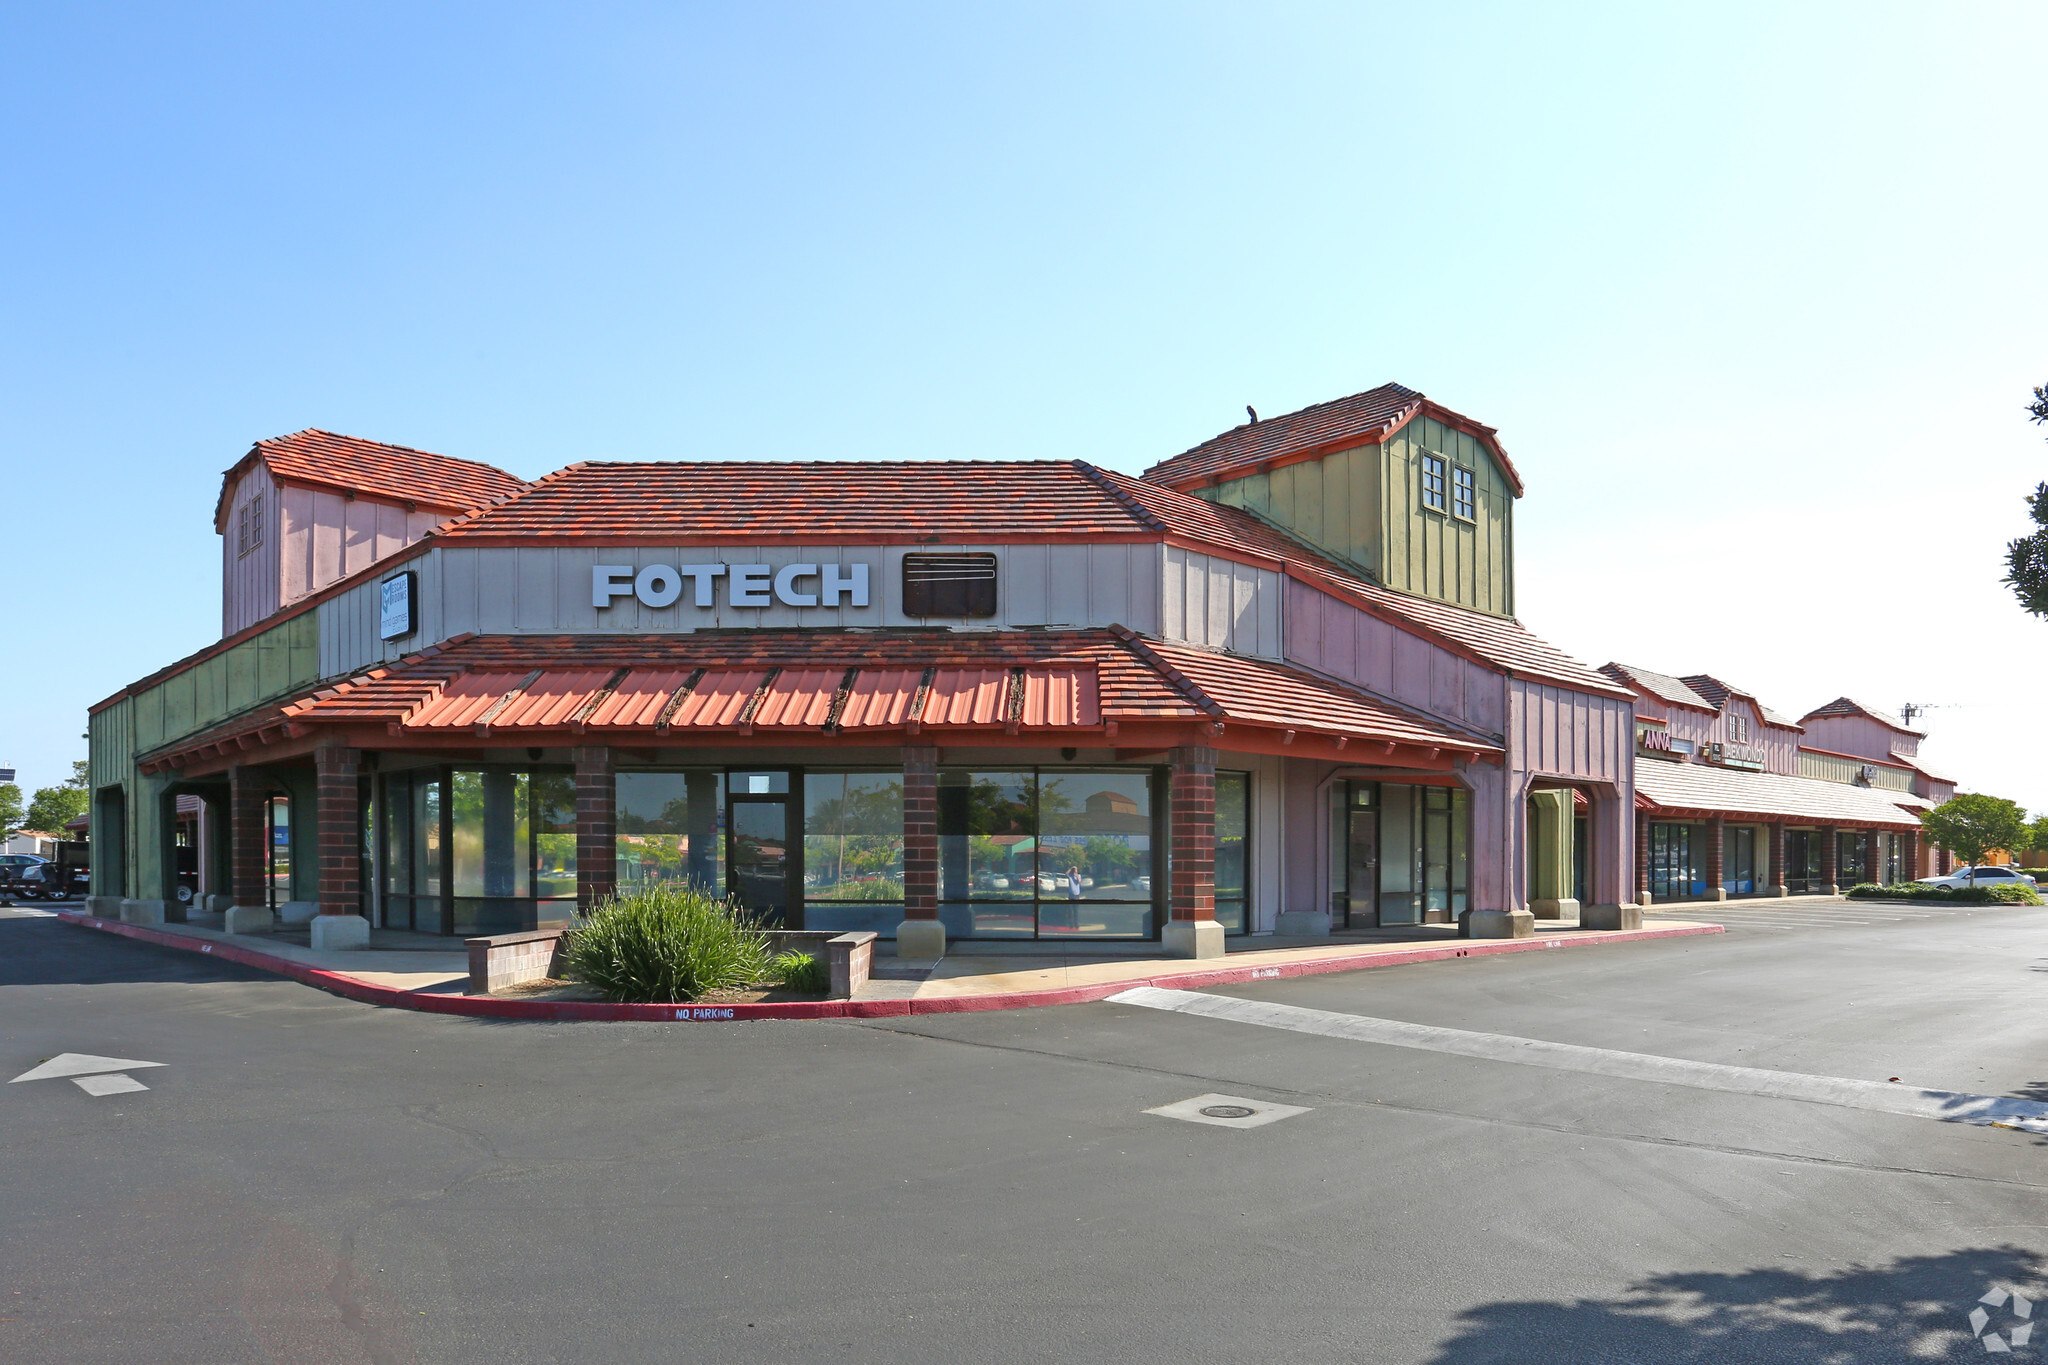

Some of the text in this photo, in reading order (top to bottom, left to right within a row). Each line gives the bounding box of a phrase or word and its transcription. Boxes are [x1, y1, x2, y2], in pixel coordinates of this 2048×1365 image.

[592, 563, 869, 607] FOTECH
[1645, 729, 1671, 751] ANNA
[1724, 743, 1765, 762] TAEKWONDO
[676, 1008, 734, 1019] NO PARKING
